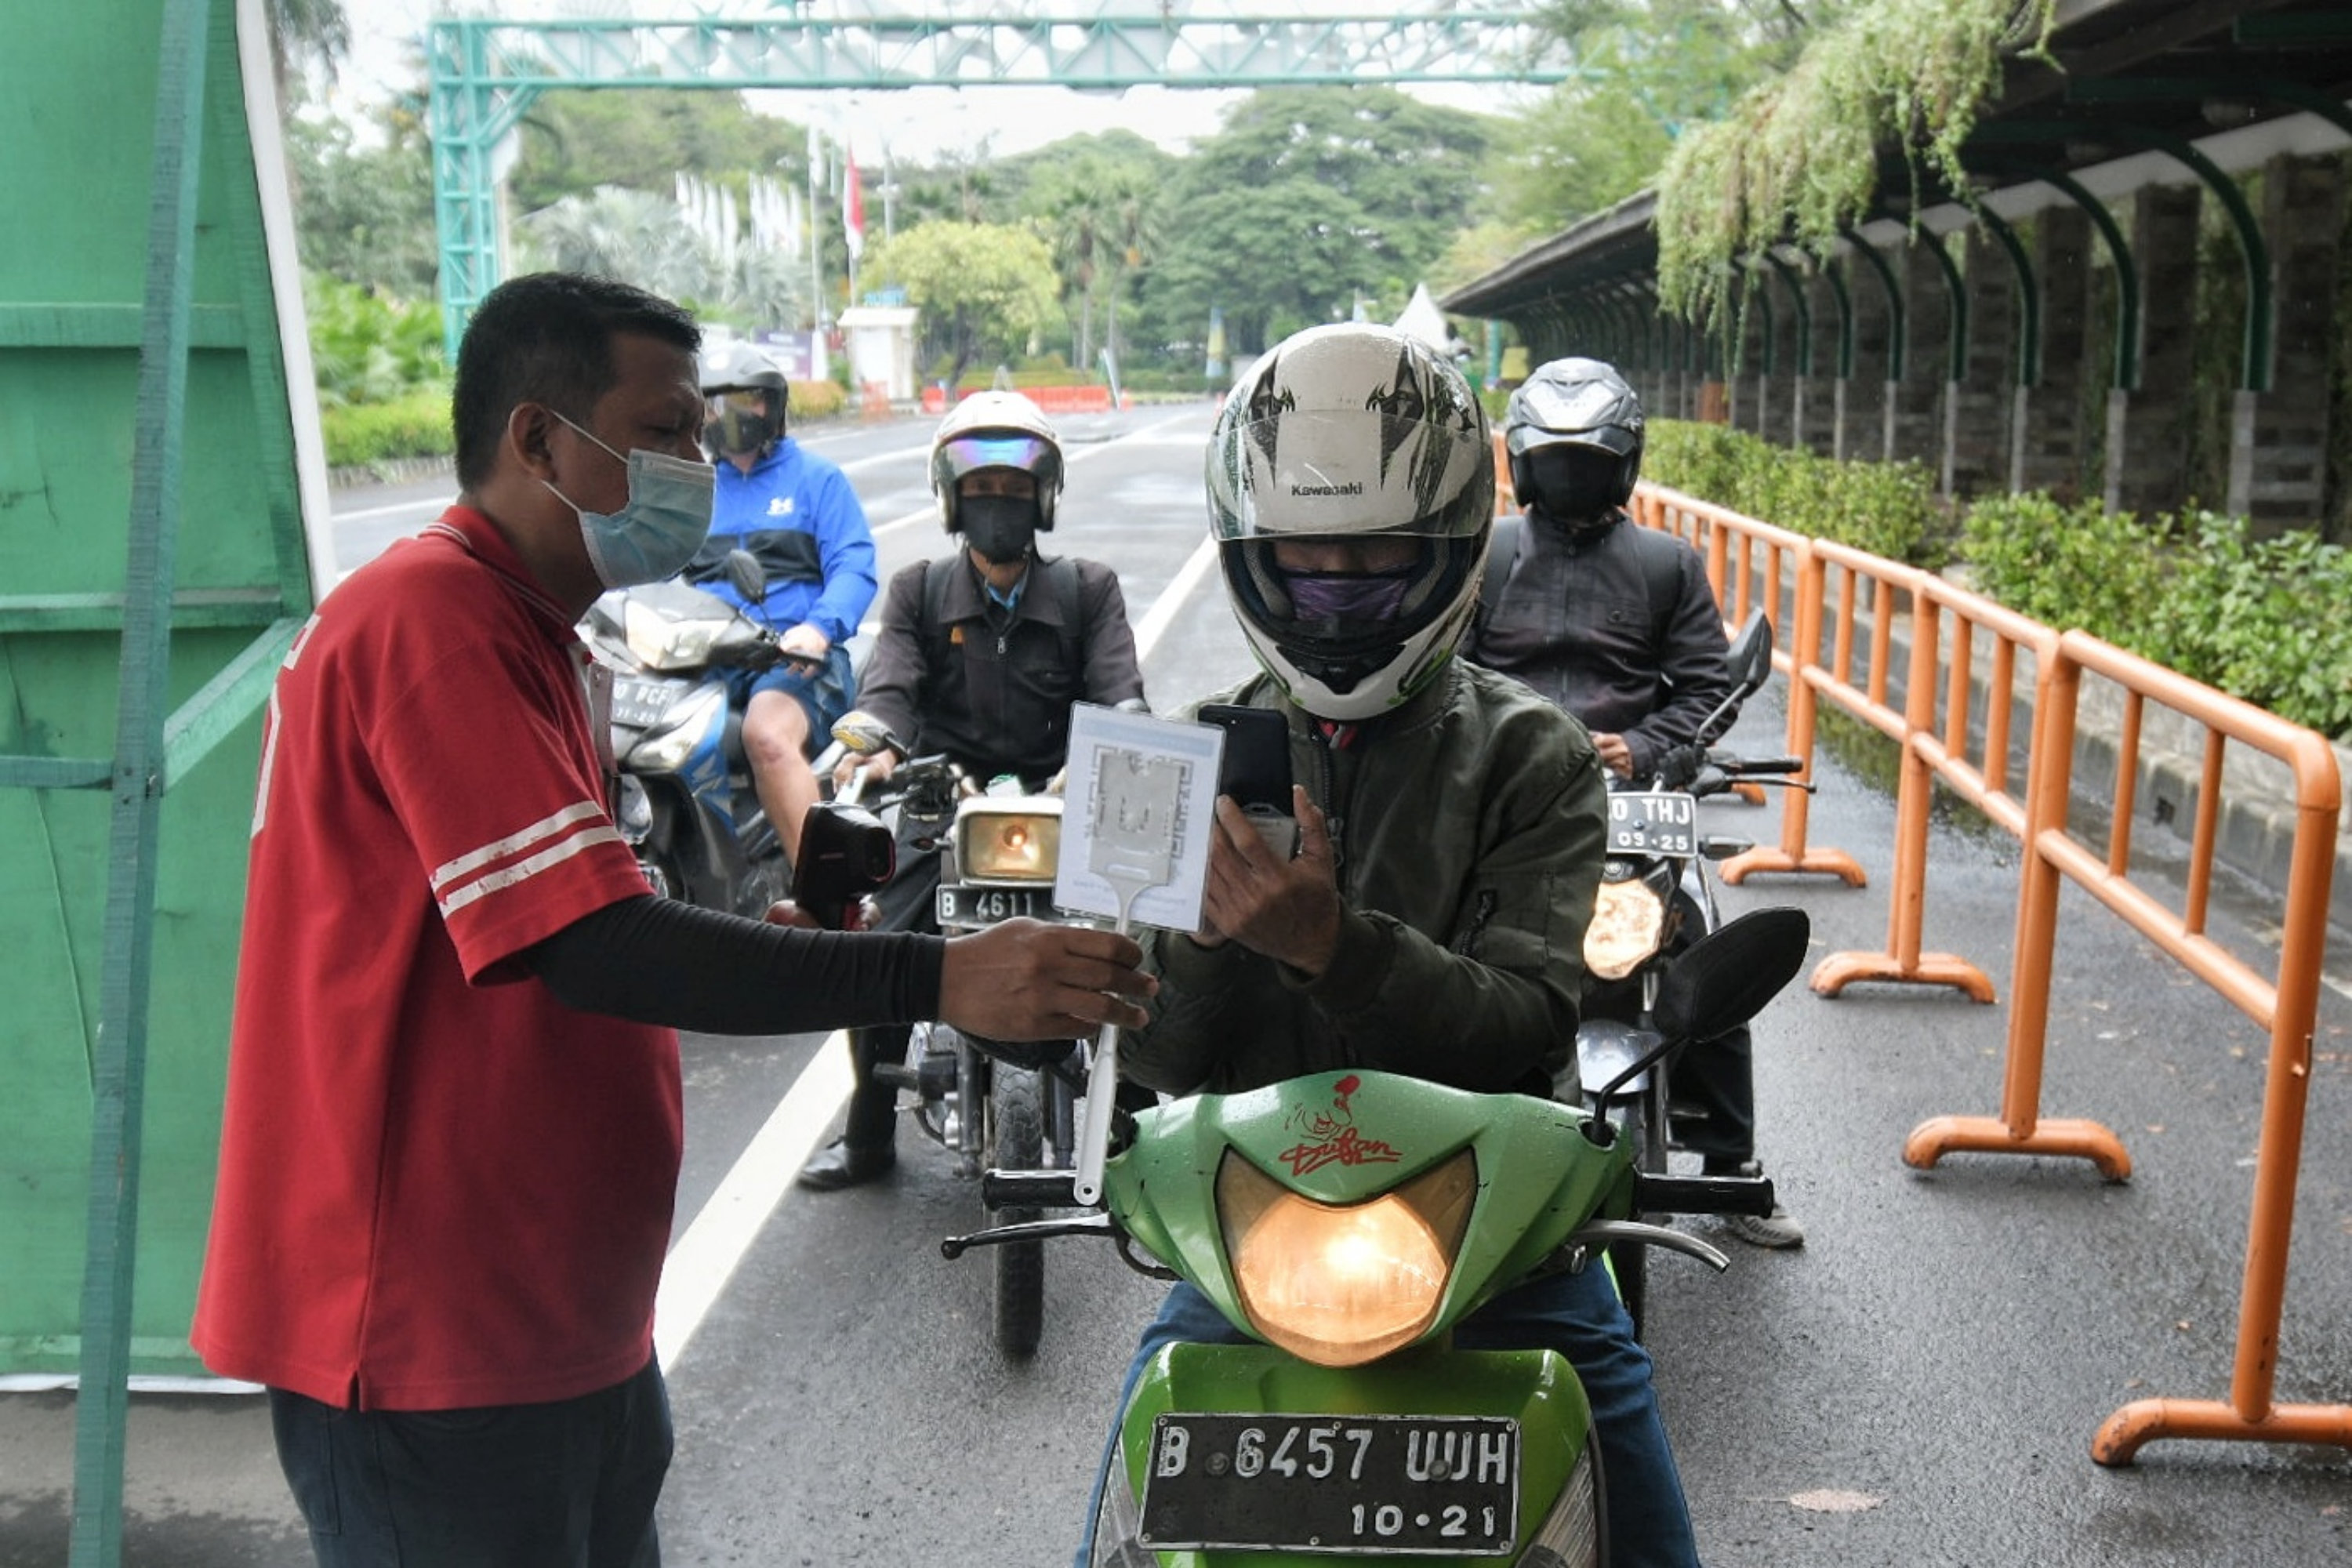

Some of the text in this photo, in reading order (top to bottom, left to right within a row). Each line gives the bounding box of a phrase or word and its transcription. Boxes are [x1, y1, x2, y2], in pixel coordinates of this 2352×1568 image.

[1291, 482, 1363, 496] Kawasaki
[1641, 798, 1690, 825] THJ
[942, 892, 956, 918] B
[1156, 1426, 1190, 1478] B
[1235, 1426, 1374, 1480] 6457
